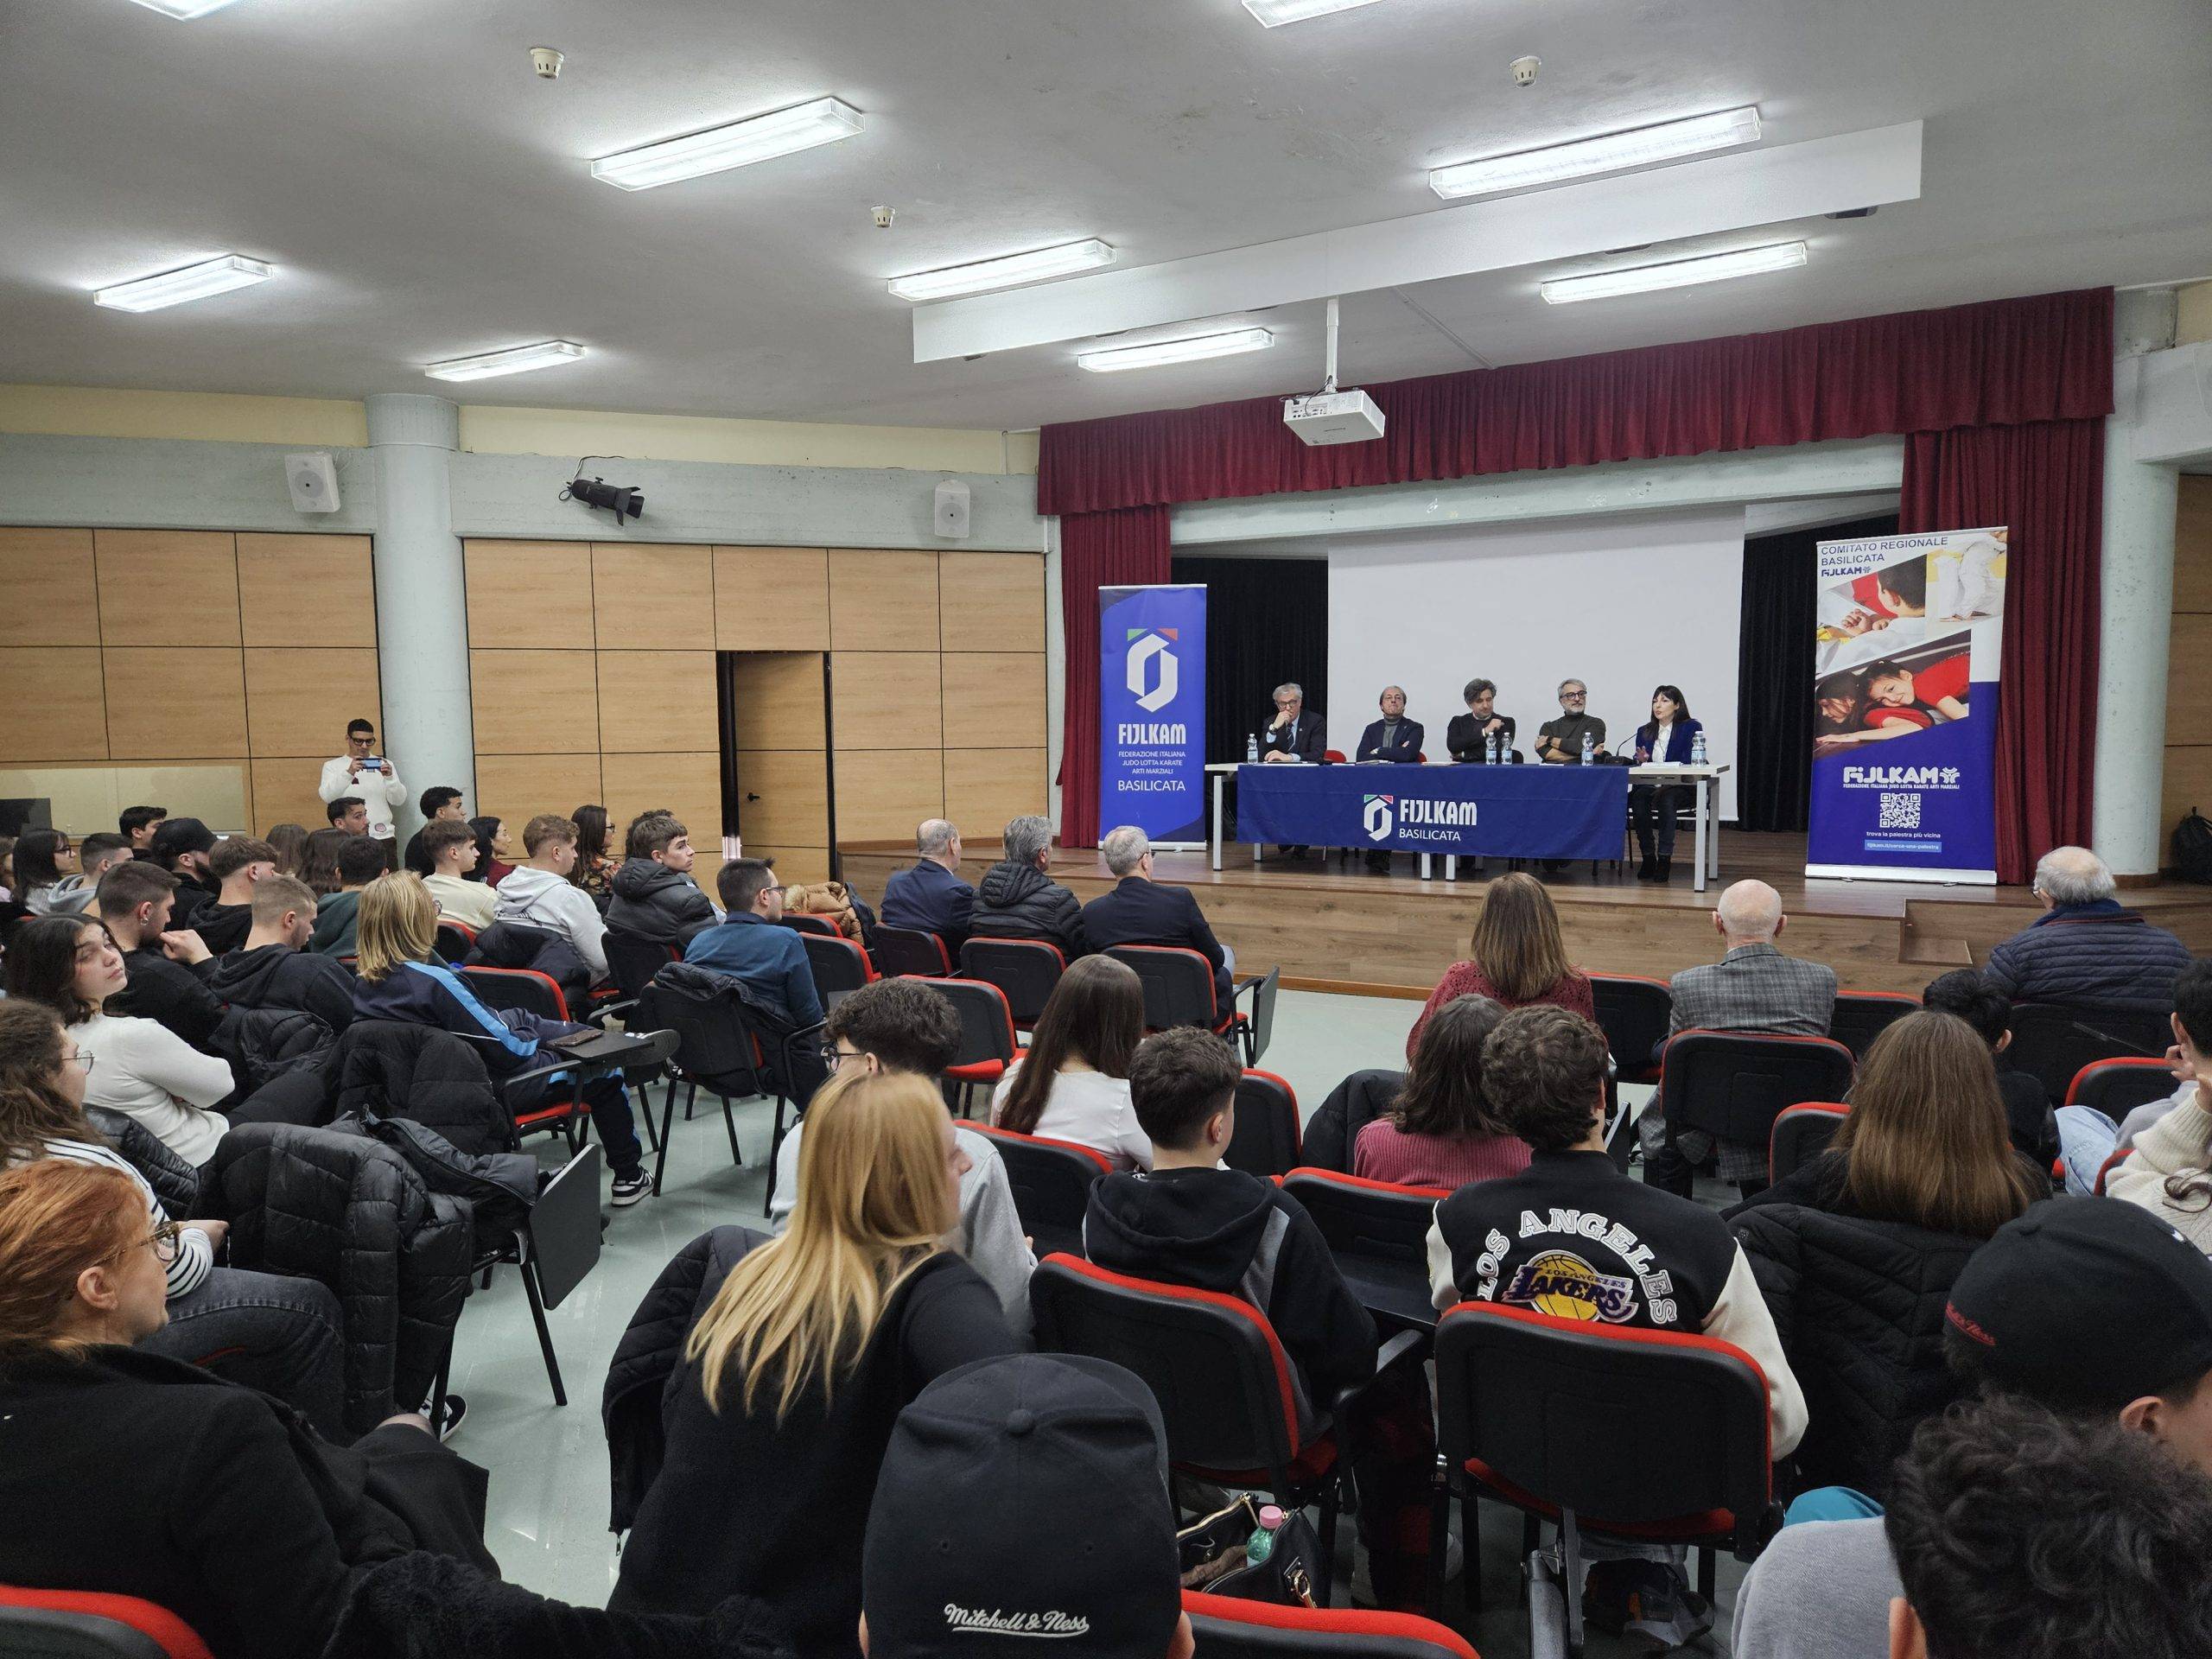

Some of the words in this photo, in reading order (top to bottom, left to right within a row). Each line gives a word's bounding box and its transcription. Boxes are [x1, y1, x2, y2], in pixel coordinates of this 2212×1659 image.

[1821, 543, 1877, 555] COMITATO
[1880, 537, 1948, 550] REGIONALE
[1821, 553, 1885, 566] BASILICATA
[1118, 723, 1186, 745] FIJLKAM
[1118, 780, 1185, 791] BASILICATA
[1400, 799, 1478, 826] FIJLKAM
[1399, 828, 1461, 842] BASILICATA
[1476, 1228, 1510, 1302] LOS
[1518, 1208, 1678, 1325] ANGELES
[1544, 1268, 1568, 1277] LOS
[1570, 1272, 1627, 1288] ANGELES
[944, 1603, 1027, 1630] Mitchell
[1025, 1612, 1043, 1630] &
[1042, 1610, 1090, 1633] Ness
